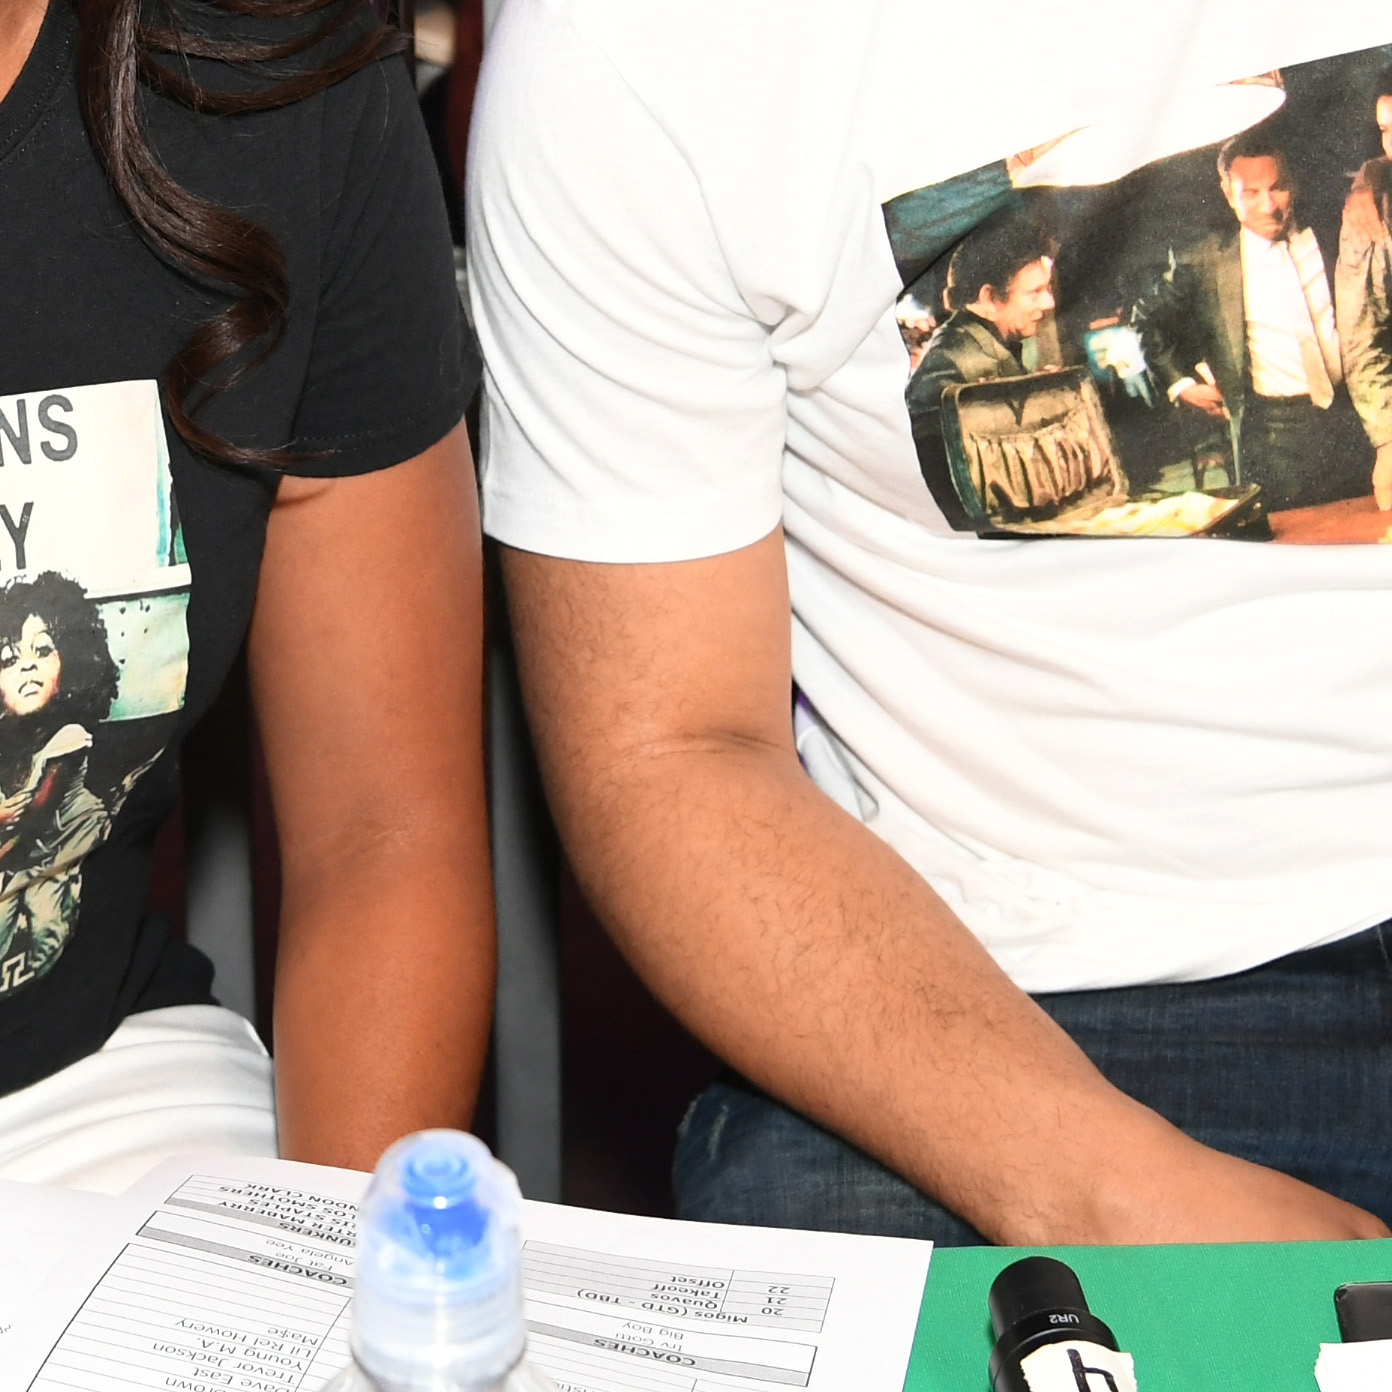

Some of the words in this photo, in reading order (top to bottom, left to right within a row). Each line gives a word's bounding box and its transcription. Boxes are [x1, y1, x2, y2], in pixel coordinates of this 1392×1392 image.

[219, 1186, 318, 1210] SMOTHERS
[246, 1183, 303, 1198] CLARK
[218, 1201, 306, 1225] MABERRY
[249, 1199, 326, 1221] STAPLES
[278, 1222, 356, 1247] UNKERS
[265, 1239, 293, 1252] Yee
[275, 1251, 300, 1264] Joe
[301, 1247, 354, 1266] Angela
[248, 1255, 348, 1285] COACHES
[670, 1274, 725, 1290] Offset
[768, 1284, 791, 1294] 22
[577, 1289, 622, 1305] TBD)
[651, 1283, 721, 1300] Takeoff
[650, 1292, 718, 1310] Quavos
[766, 1296, 787, 1305] 21
[641, 1301, 688, 1317] (GTD
[761, 1307, 784, 1316] 20
[694, 1311, 748, 1324] Migos
[1048, 1313, 1080, 1325] UR2
[174, 1317, 248, 1343] Howery
[622, 1321, 653, 1335] Boy
[659, 1328, 684, 1341] Big
[197, 1337, 237, 1355] M.A.
[254, 1337, 284, 1352] Rel
[616, 1332, 654, 1346] Gotti
[660, 1341, 684, 1352] Irv
[152, 1342, 229, 1368] Jackson
[244, 1347, 303, 1371] Young
[289, 1344, 312, 1358] Lil
[593, 1338, 697, 1367] COACHES
[193, 1367, 234, 1385] East
[233, 1360, 296, 1384] Trevor
